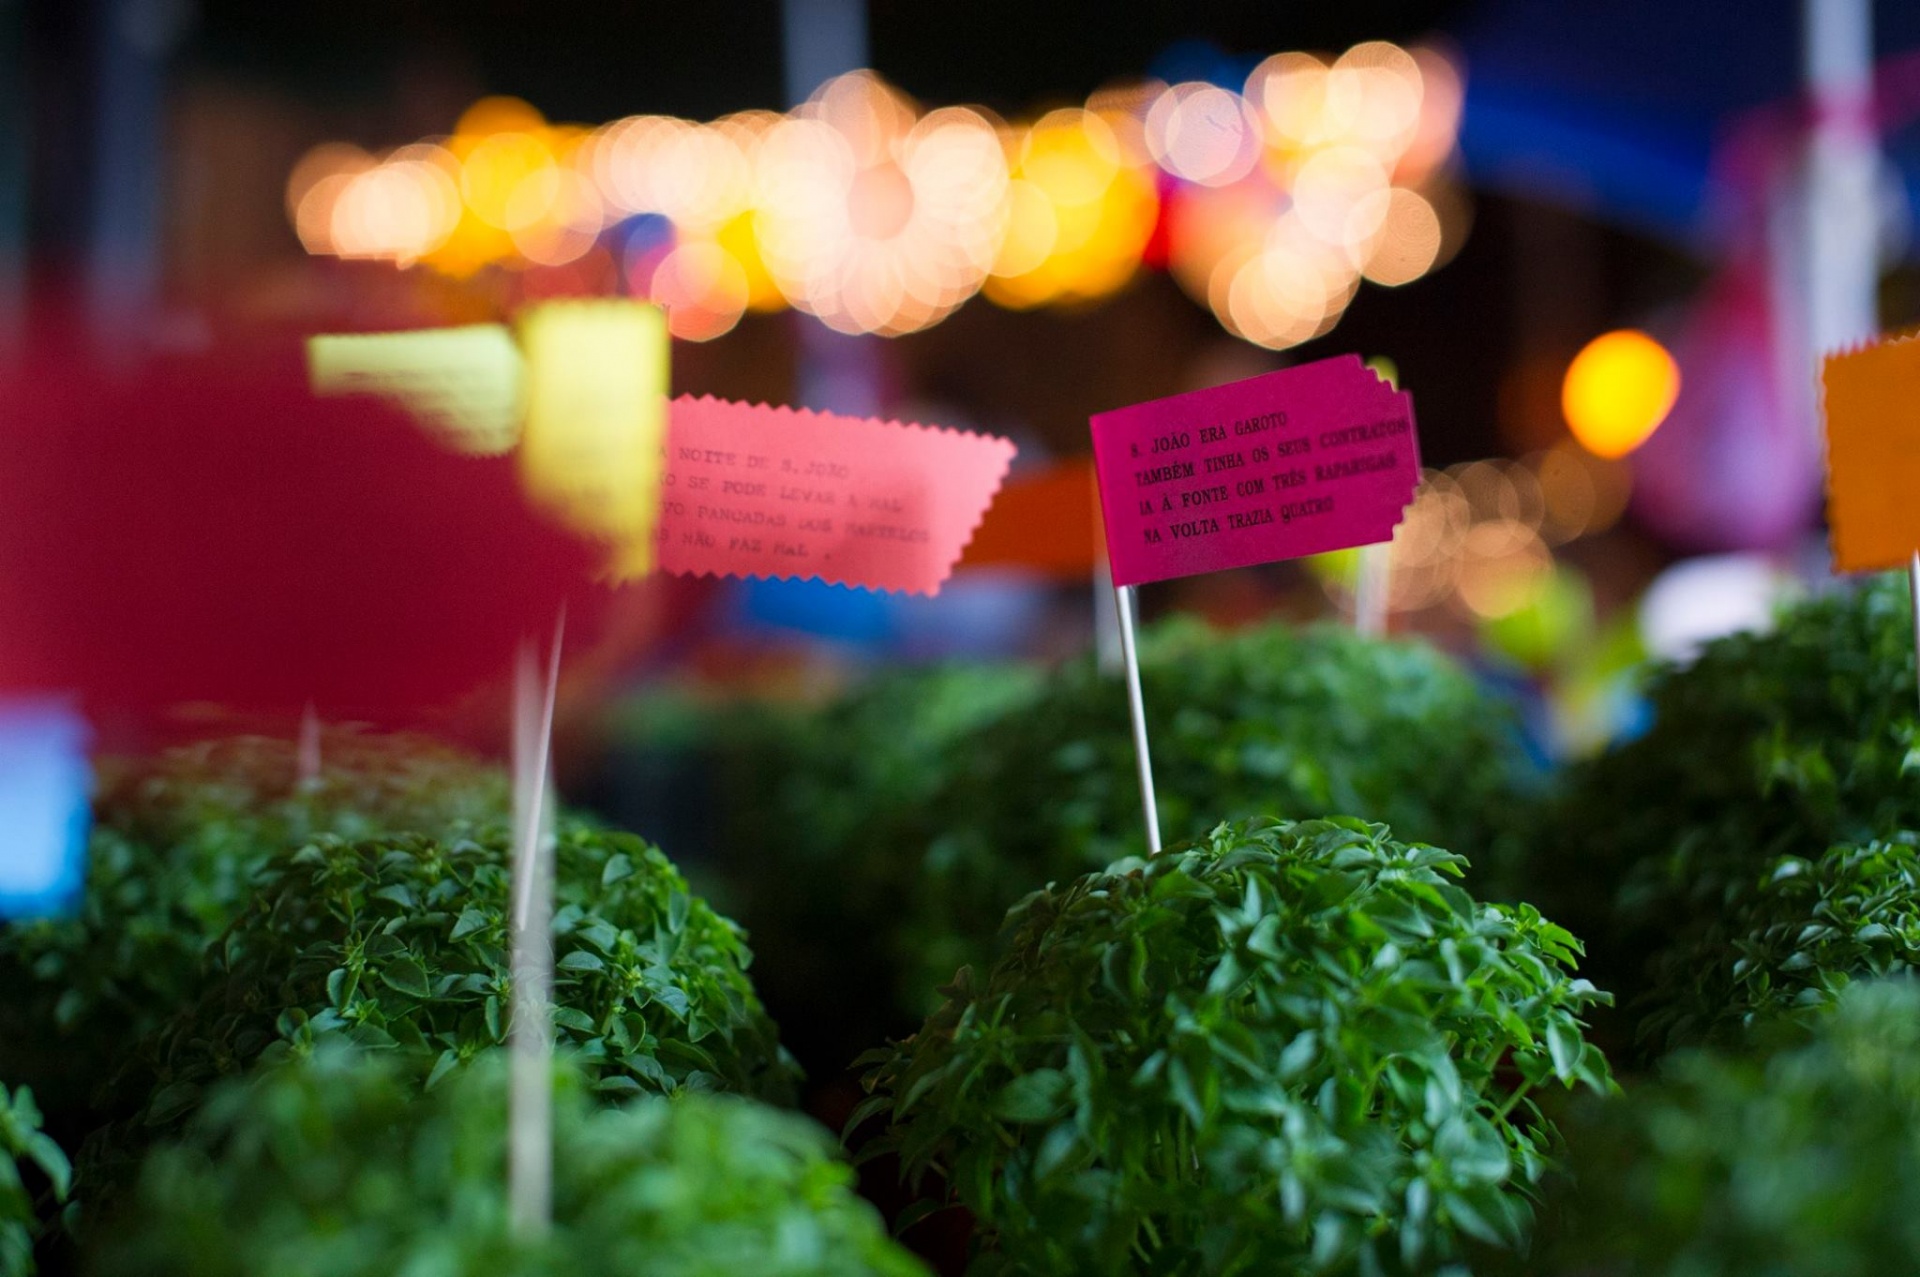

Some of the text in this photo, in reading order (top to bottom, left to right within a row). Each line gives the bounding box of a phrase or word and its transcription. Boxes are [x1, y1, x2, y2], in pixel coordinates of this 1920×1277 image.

[1151, 431, 1190, 453] JOÃO
[1199, 425, 1227, 444] ERA
[1234, 411, 1287, 436] GAROTO
[679, 447, 736, 466] NOITE
[747, 455, 769, 470] DE
[1134, 418, 1407, 487] TAMBÉM TINHA OS SEUS CONTRATOS
[688, 476, 709, 490] SE
[722, 480, 767, 497] PODE
[780, 486, 835, 505] LEVAR
[1181, 485, 1228, 507] FONTE
[1236, 478, 1265, 497] COM
[1272, 469, 1306, 490] TRÊS
[1315, 451, 1396, 481] RAPARIGAS
[698, 505, 786, 527] PANCADAS
[1143, 497, 1334, 543] NA VOLTA TRAZIA QUATRO
[682, 529, 716, 548] NÃO
[729, 536, 762, 553] FAZ
